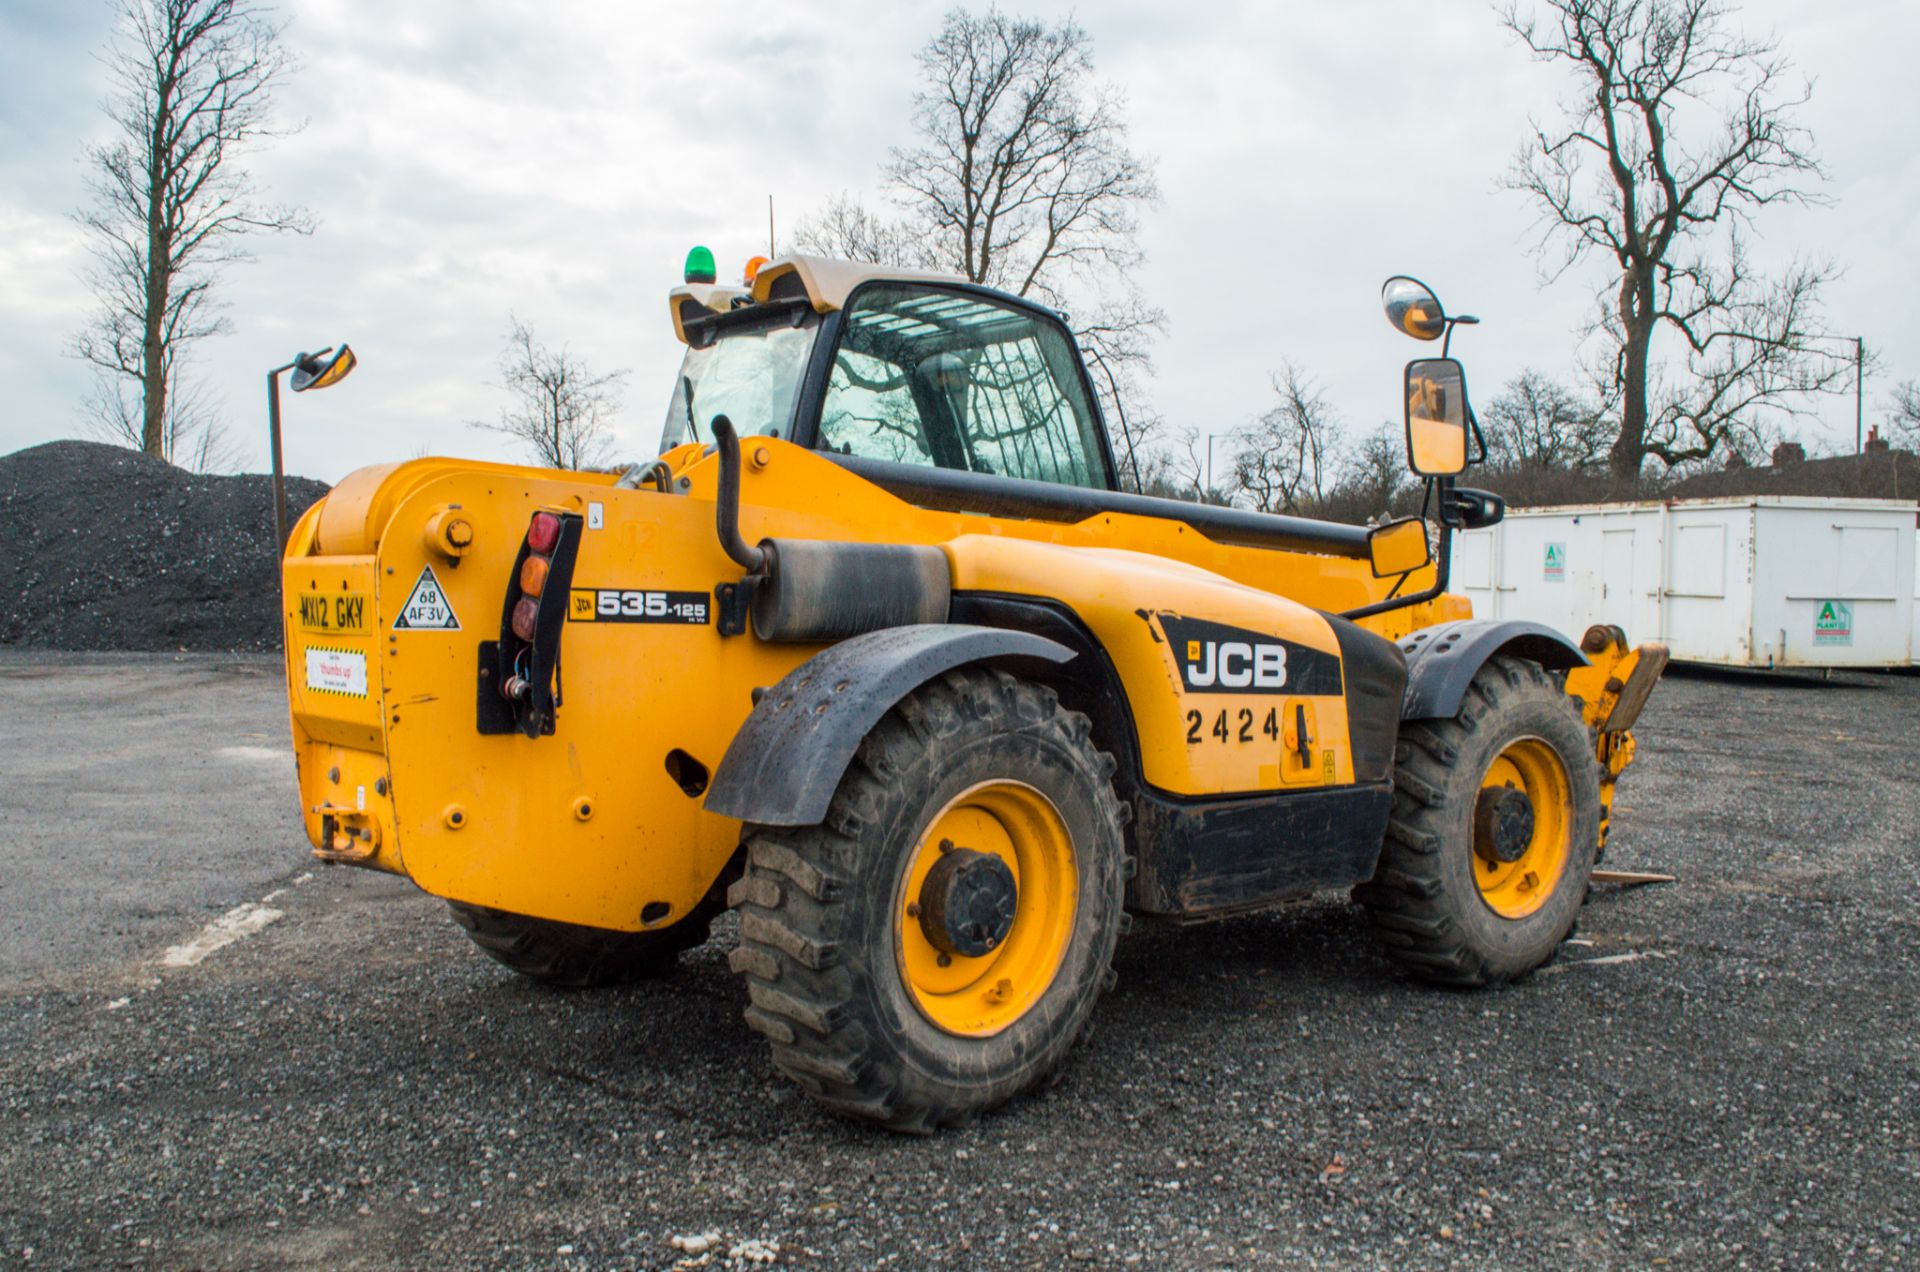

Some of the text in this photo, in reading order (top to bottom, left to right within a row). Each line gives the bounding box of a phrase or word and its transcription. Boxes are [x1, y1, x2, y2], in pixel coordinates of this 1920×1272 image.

[300, 596, 364, 629] MX12 GKY
[419, 590, 436, 604] 68
[1186, 640, 1288, 688] JCB
[1186, 706, 1279, 744] 2424
